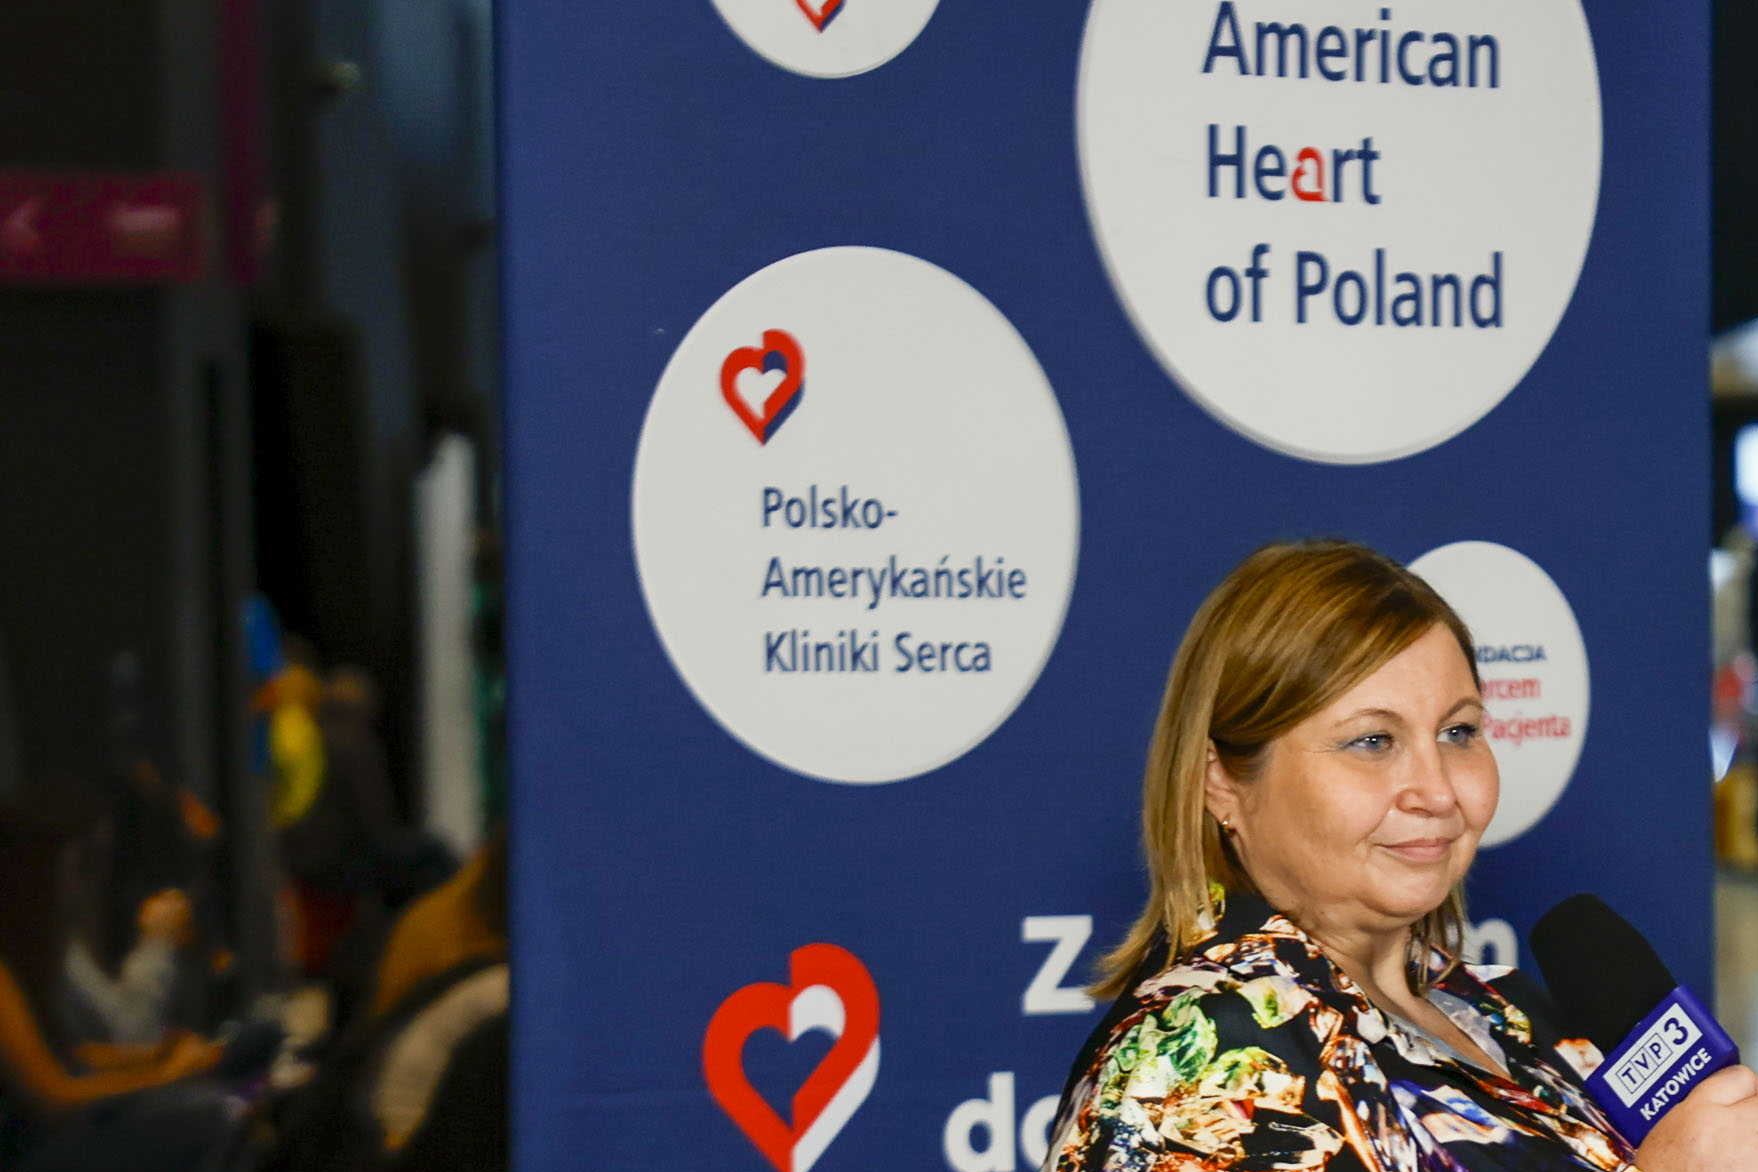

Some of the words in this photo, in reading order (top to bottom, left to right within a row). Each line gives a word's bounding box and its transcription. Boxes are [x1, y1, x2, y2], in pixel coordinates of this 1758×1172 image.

[1202, 1, 1500, 89] American
[1207, 124, 1382, 205] Heart
[1206, 244, 1271, 323] of
[1296, 248, 1504, 328] Poland
[762, 484, 898, 529] Polsko-
[761, 554, 1028, 610] Amerykańskie
[764, 629, 880, 673] Kliniki
[894, 631, 993, 673] Serca
[1640, 1047, 1712, 1121] KATOWICE
